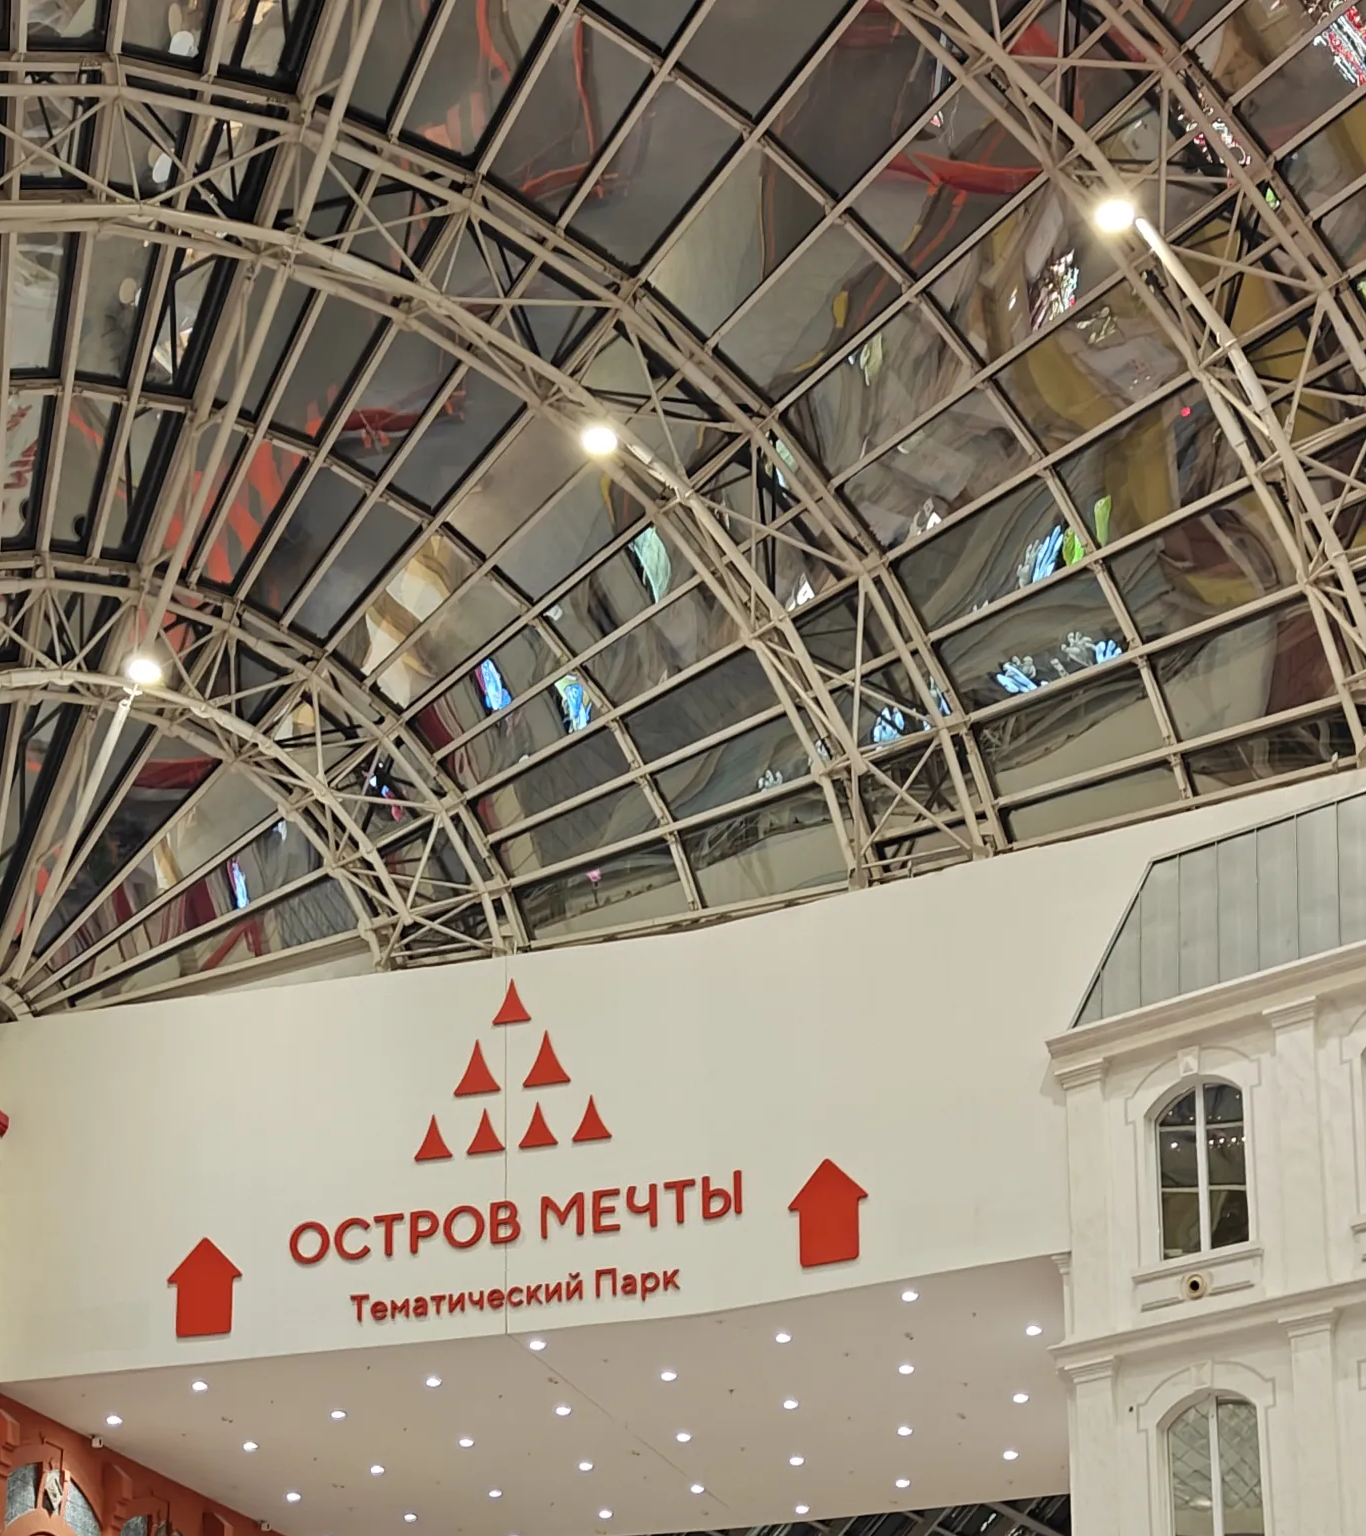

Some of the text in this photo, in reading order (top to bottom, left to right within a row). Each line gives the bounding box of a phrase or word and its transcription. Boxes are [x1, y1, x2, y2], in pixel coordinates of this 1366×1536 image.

[289, 1170, 743, 1265] ОСТРОВ МЕЧТЫ
[350, 1267, 681, 1323] Тематический Парк
